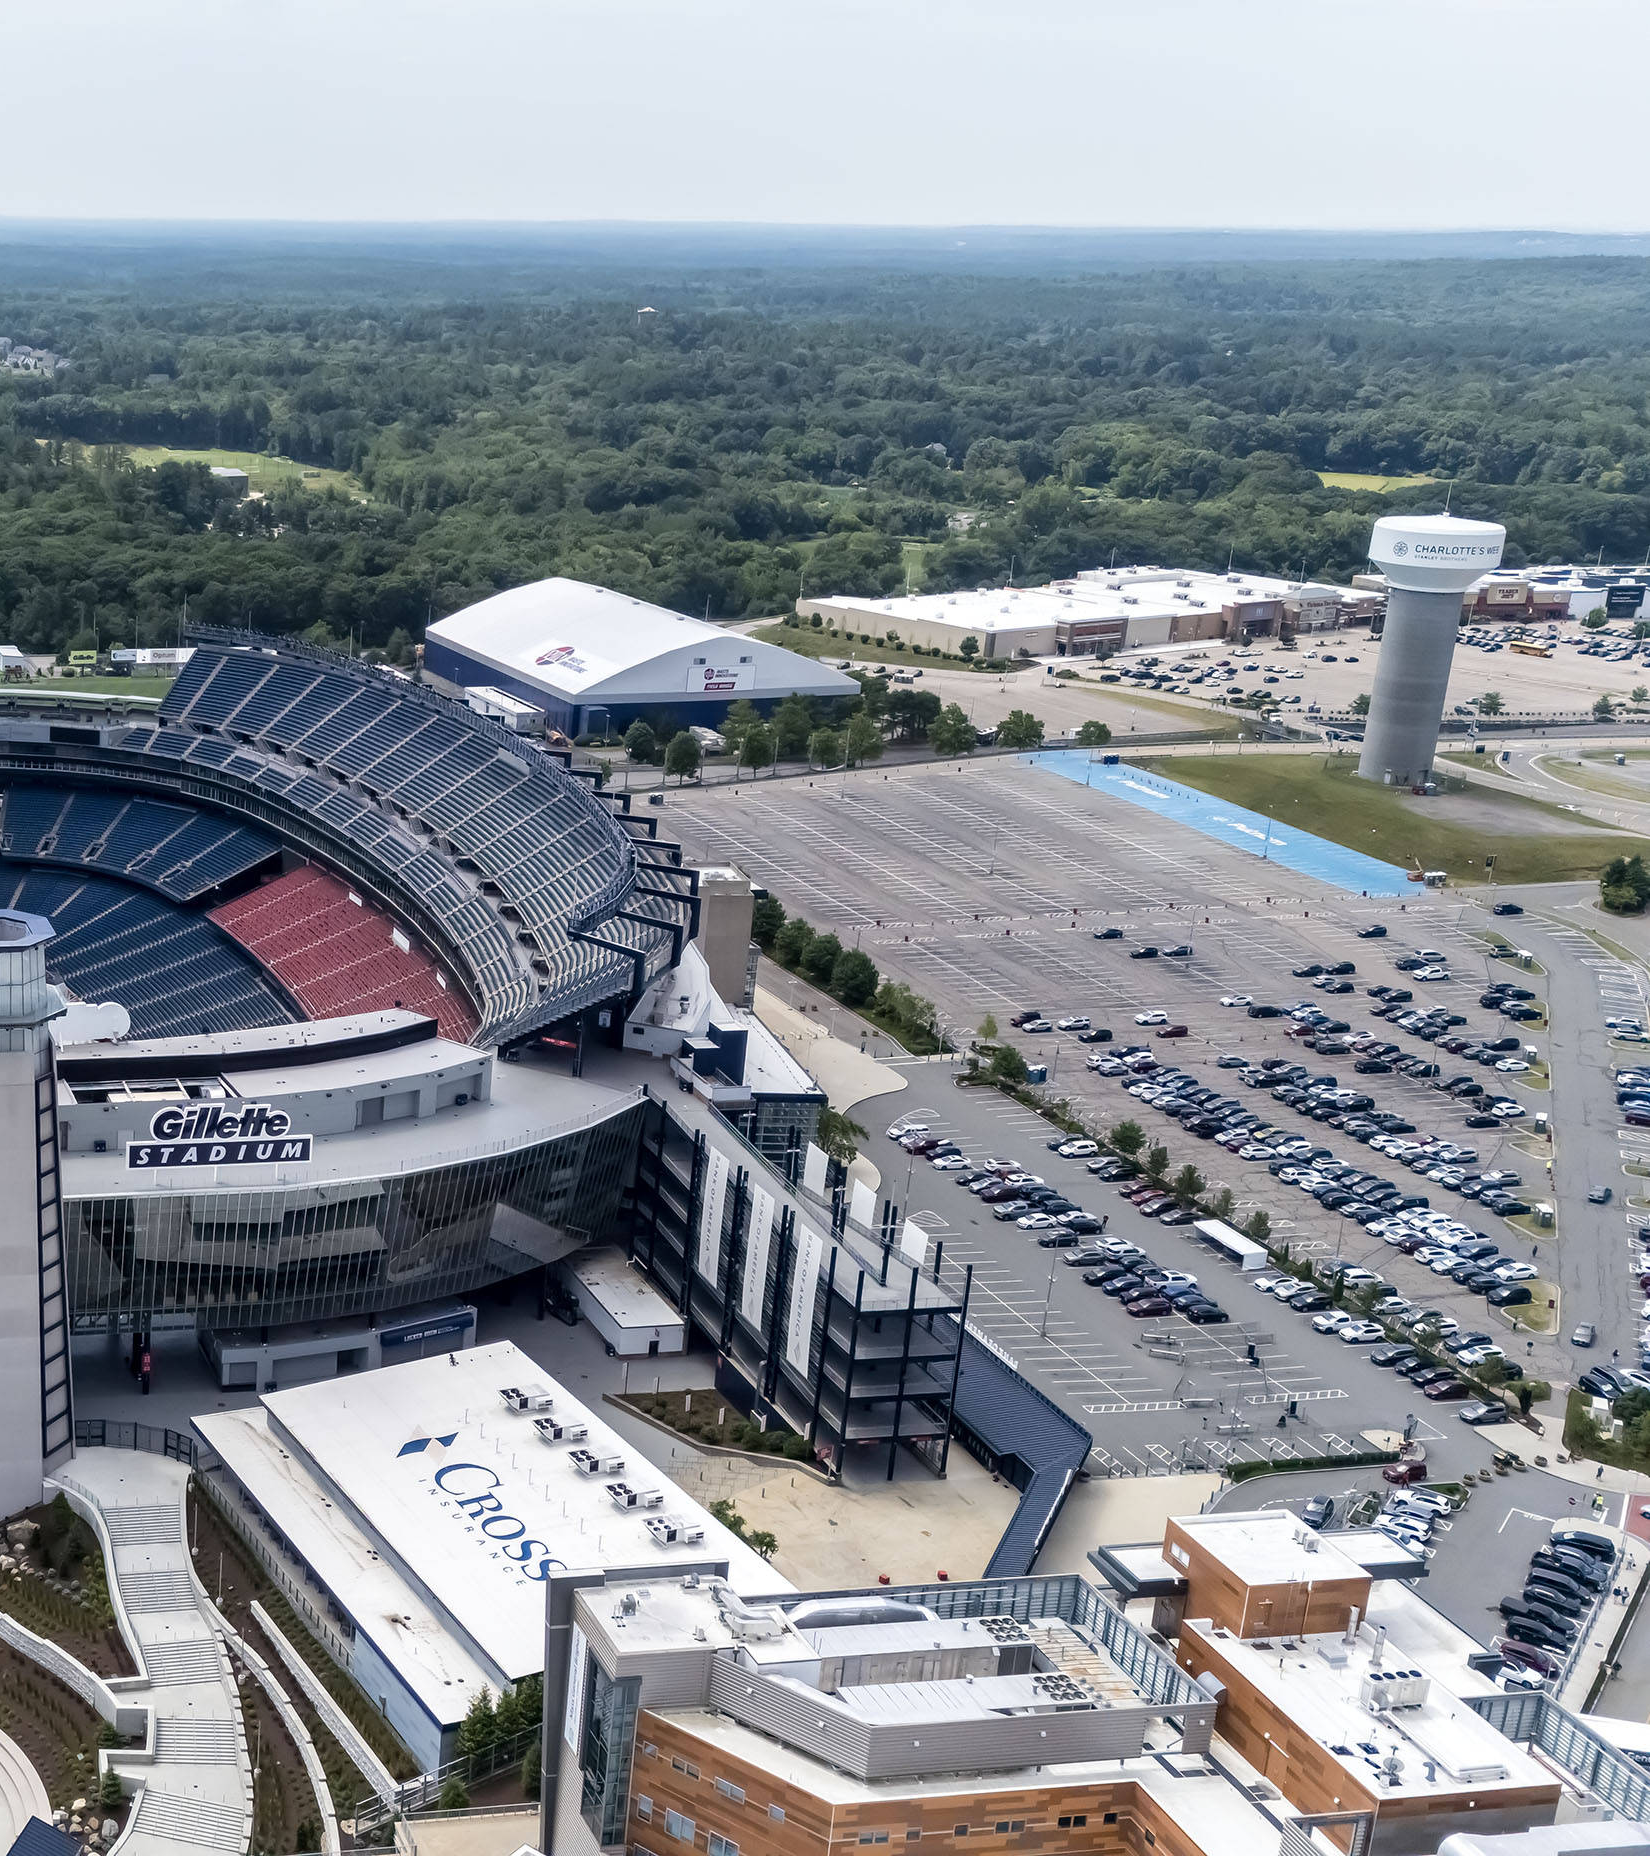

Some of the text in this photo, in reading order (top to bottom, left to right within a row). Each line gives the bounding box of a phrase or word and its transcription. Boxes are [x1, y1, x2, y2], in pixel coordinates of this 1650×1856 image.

[1415, 544, 1485, 556] CHARLOTTE'S
[151, 1105, 290, 1142] Gillette
[137, 1141, 305, 1168] STADIUM
[418, 1478, 526, 1587] INSURANCE
[434, 1463, 568, 1582] CROSS
[1627, 1751, 1650, 1764] Gen
